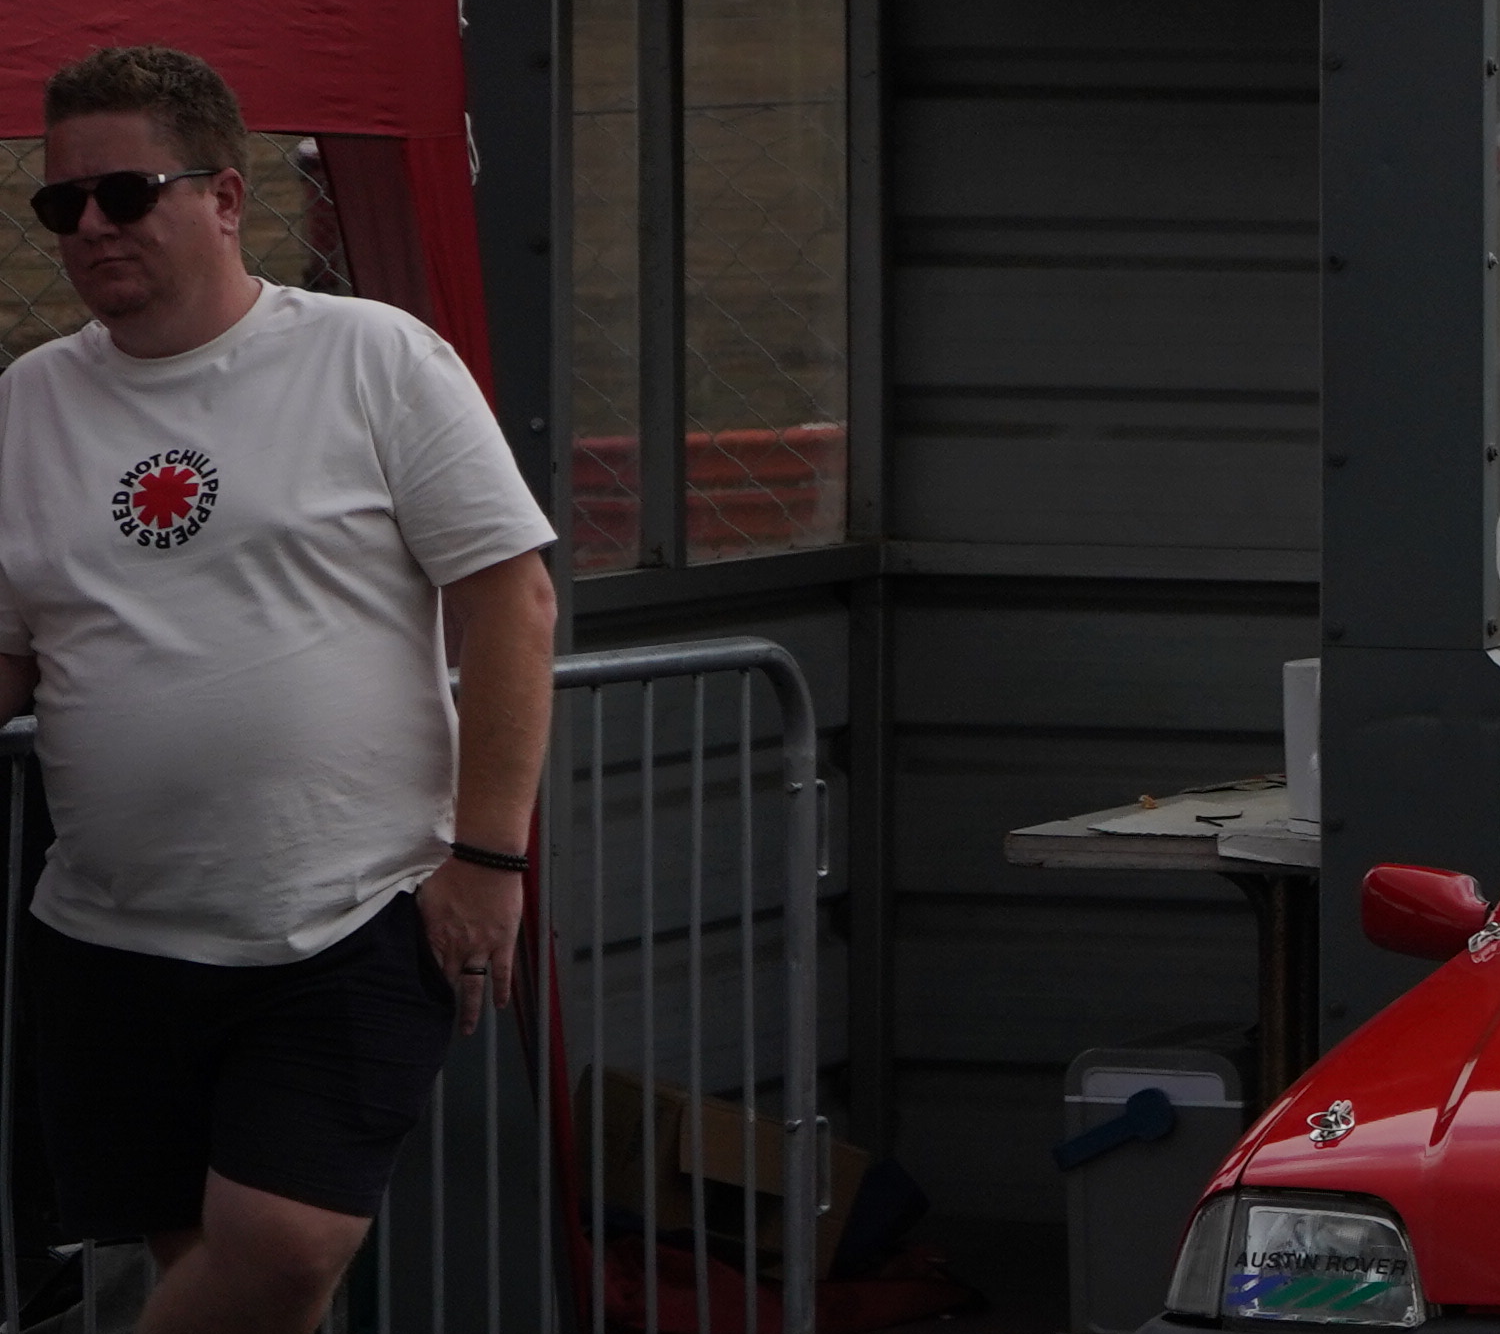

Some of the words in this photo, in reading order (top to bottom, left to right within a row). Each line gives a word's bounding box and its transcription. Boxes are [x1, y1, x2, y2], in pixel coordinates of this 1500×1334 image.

[120, 454, 161, 488] HOT
[165, 449, 217, 479] CHILI
[112, 491, 140, 537] RED
[137, 479, 219, 549] PEPPERS
[1235, 1252, 1318, 1272] AUSTIN
[1325, 1254, 1407, 1277] ROVER
